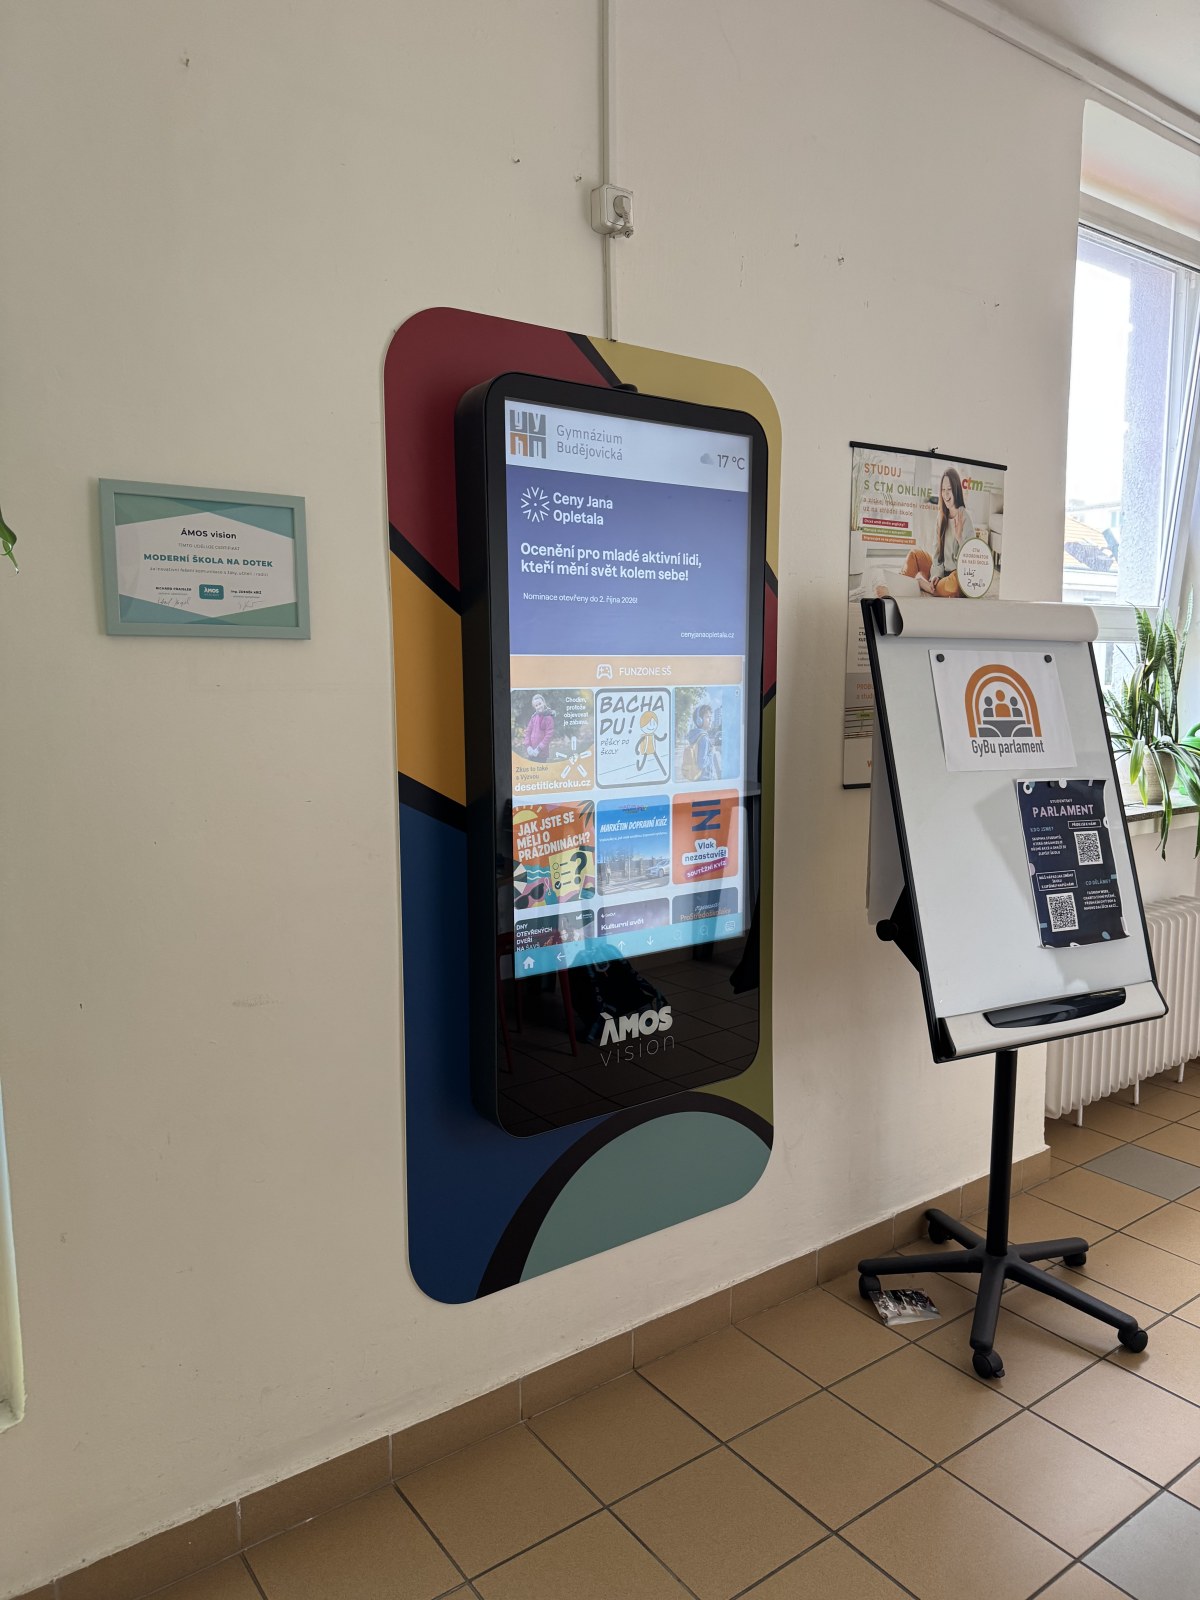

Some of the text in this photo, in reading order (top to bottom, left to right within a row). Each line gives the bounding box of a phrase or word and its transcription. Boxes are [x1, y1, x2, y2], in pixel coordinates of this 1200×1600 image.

[556, 424, 623, 445] Gymnázium
[557, 441, 623, 461] Budějovická
[717, 454, 729, 469] 17
[864, 463, 902, 478] STUDUJ
[863, 480, 932, 498] S CTM ONLINE
[961, 477, 983, 491] ctm
[553, 492, 613, 510] Ceny Jana
[553, 509, 604, 526] Opletala
[180, 528, 237, 540] ÁMOS vision
[143, 553, 273, 568] MODERNÍ ŠKOLA NA DOTEK
[520, 542, 702, 569] Ocenění pro mladé aktivní lidi,
[521, 559, 689, 581] kteří mění svět kolem sebe!
[523, 592, 558, 601] Nominace
[558, 594, 588, 604] otevřeny
[589, 595, 599, 603] do
[619, 665, 672, 676] FUNZONE SŠ
[599, 695, 665, 714] BACHA
[600, 748, 618, 756] ŠKOLY
[971, 738, 1045, 758] GyBu parlament
[514, 779, 591, 792] desetitickroku.cz
[1032, 804, 1094, 818] PARLAMENT
[518, 811, 575, 837] JAK JSTE SE
[600, 815, 668, 833] MARKÉTIN DOPRAVNÍ KVÍZ
[516, 831, 550, 850] MĚLI O
[517, 832, 591, 863] PRÁZDNINÁCH?
[697, 841, 714, 850] Vlak
[684, 849, 727, 863] nezastavíš!
[687, 860, 727, 878] SOUTĚŽNÍ KVÍZ
[516, 923, 528, 931] DNY
[516, 926, 553, 938] OTEVŘENÝCH
[601, 920, 629, 931] Kulturní
[516, 936, 533, 945] DVEŘÍ
[600, 1035, 675, 1067] vision
